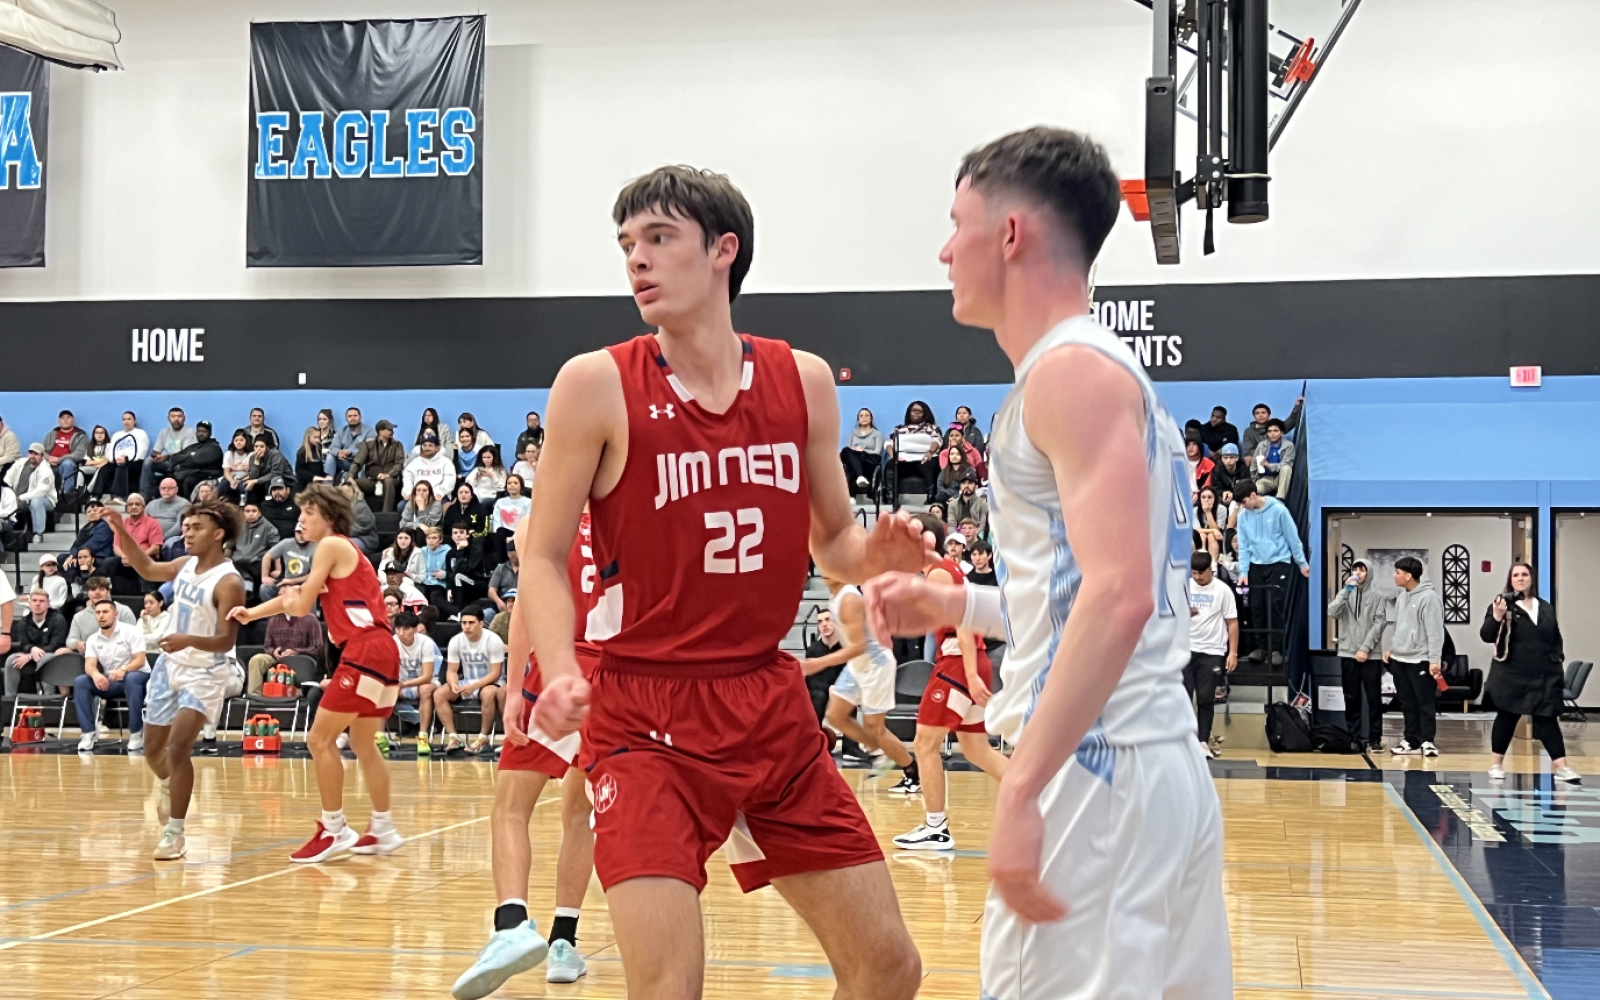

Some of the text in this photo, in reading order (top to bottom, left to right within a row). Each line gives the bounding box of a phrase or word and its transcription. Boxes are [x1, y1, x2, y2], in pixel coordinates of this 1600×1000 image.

[255, 107, 476, 180] EAGLES
[131, 328, 205, 362] HOME
[1516, 368, 1537, 383] EXIT
[416, 468, 442, 476] TEXAS
[655, 441, 800, 510] JIM NED
[704, 507, 764, 574] 22
[255, 739, 264, 749] G
